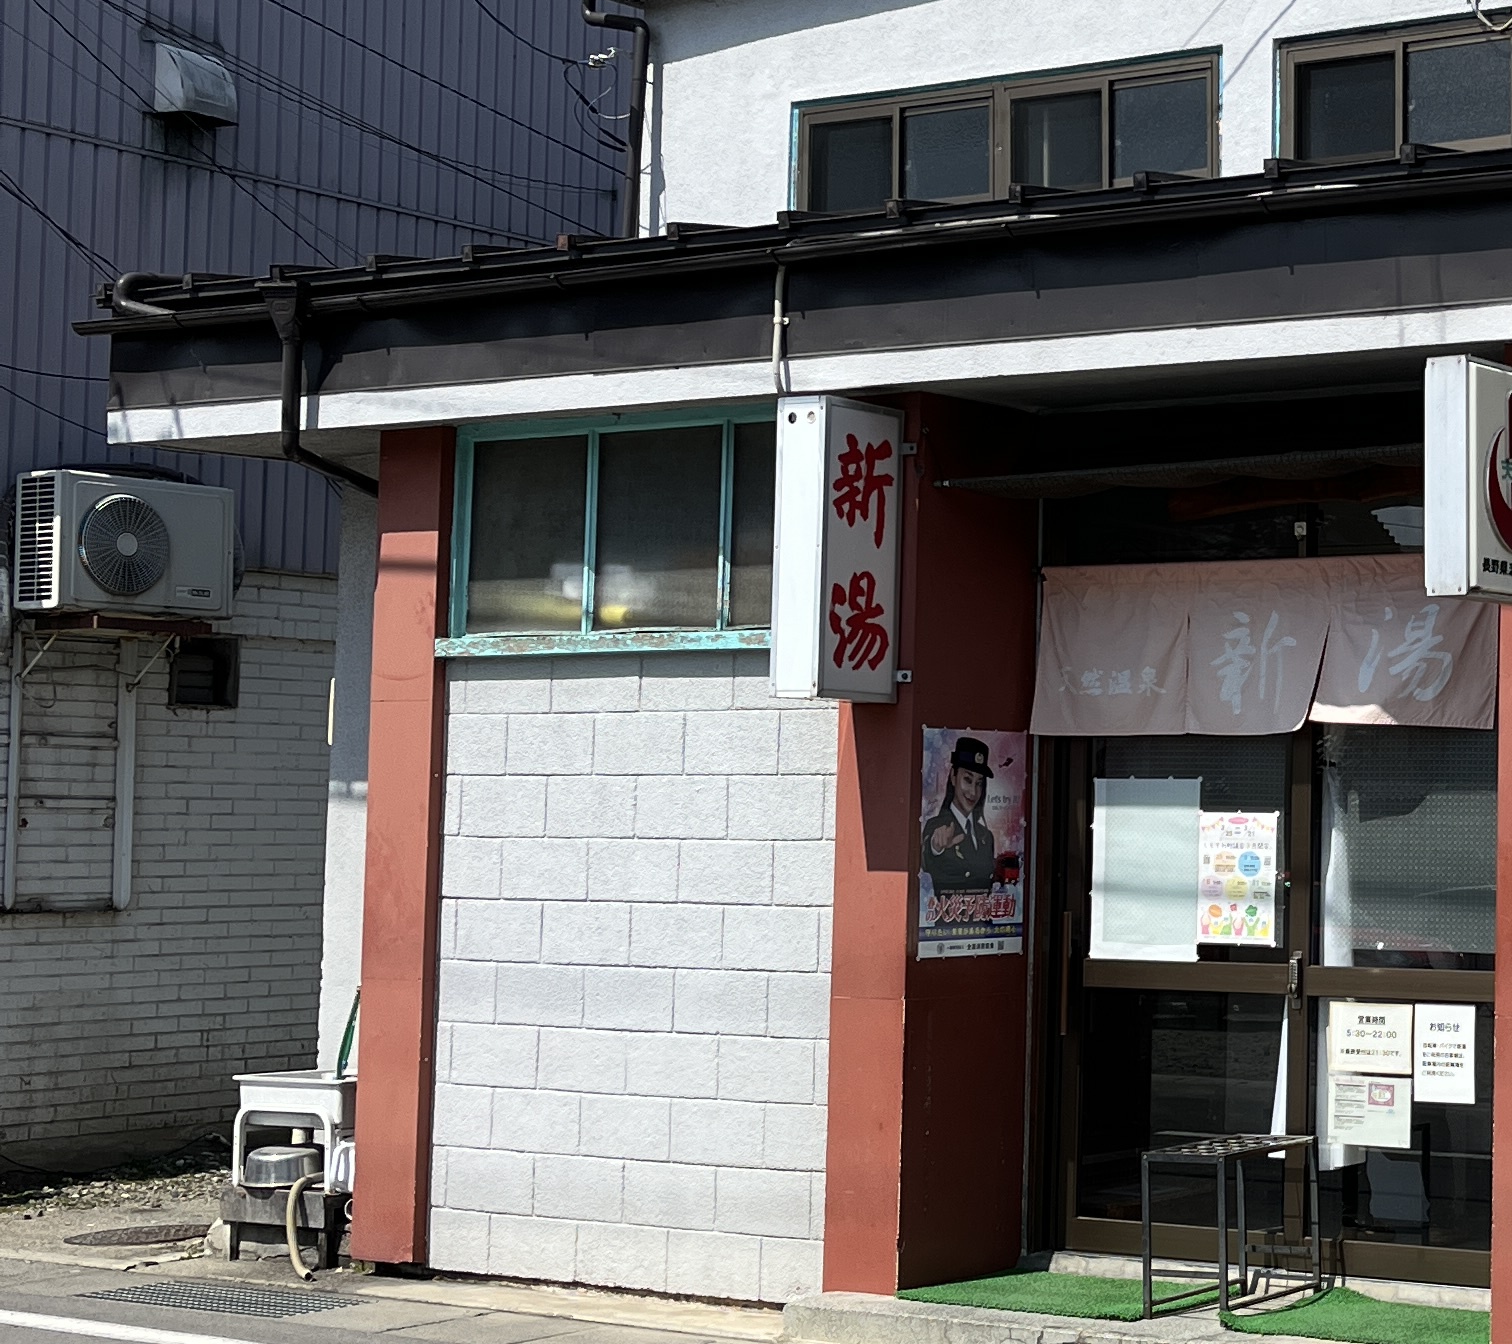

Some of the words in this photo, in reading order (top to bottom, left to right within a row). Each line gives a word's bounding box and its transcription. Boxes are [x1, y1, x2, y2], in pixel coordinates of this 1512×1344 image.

[829, 433, 894, 671] 新湯
[1357, 1015, 1386, 1025] 営業時間
[1429, 1022, 1460, 1033] お知らせ
